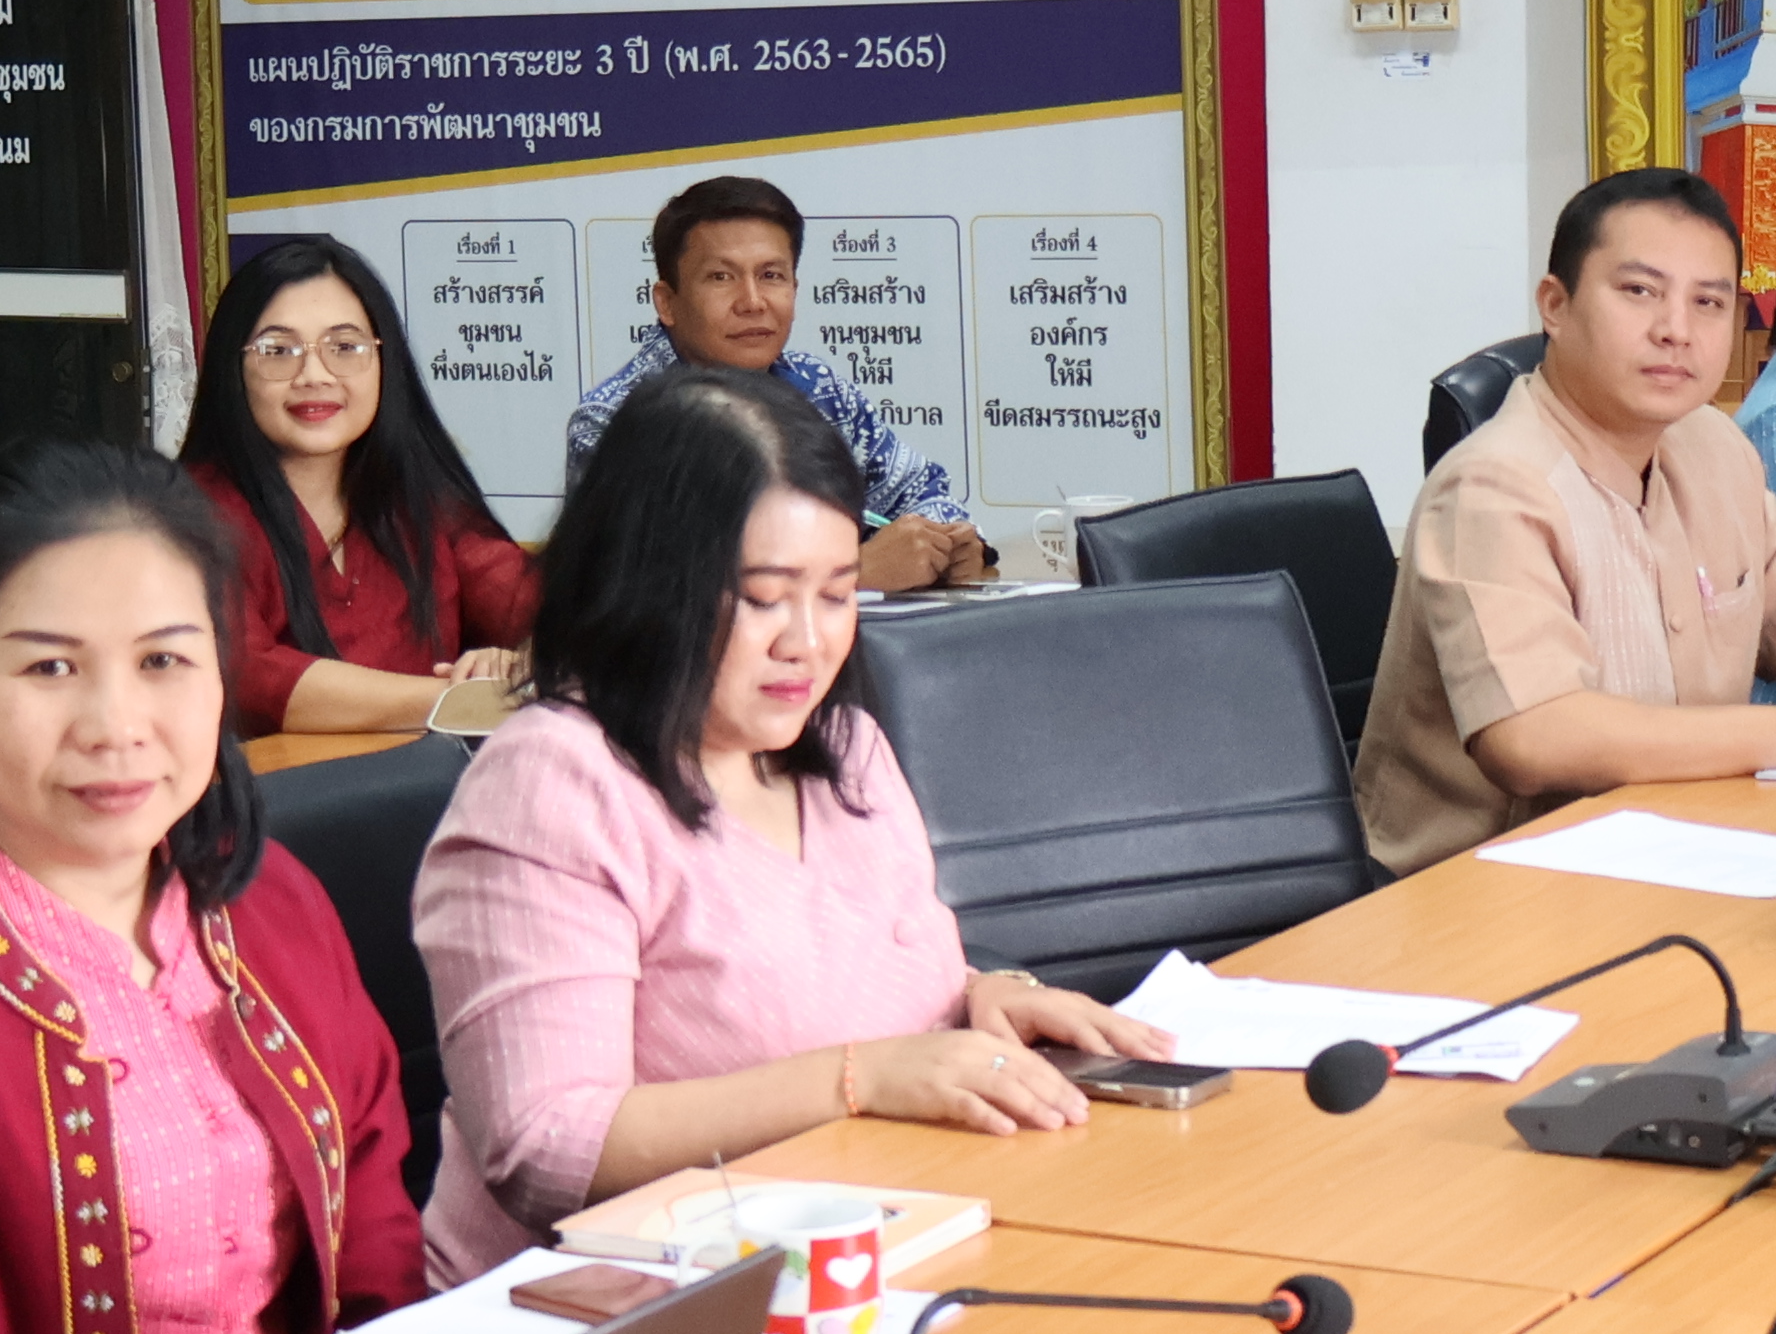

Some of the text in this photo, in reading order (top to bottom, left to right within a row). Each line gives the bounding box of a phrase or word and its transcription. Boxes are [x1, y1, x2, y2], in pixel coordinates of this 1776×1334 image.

[248, 43, 583, 92] แผนปฏิบัติราชการระยะ
[596, 43, 614, 75] 3
[624, 33, 650, 75] ปี
[665, 40, 739, 81] (พ.ศ.
[753, 38, 832, 72] 2563
[249, 102, 602, 154] ของกรมการพัฒนาชุมชน
[456, 233, 517, 257] เรื่องที่ 1
[831, 233, 897, 257] เรื่องที่ 3
[1030, 232, 1098, 257] เรื่องที่ 4
[432, 277, 545, 309] สร้างสรรค์
[812, 277, 927, 309] เสริมสร้าง
[1009, 277, 1128, 309] เสริมสร้าง
[458, 319, 523, 347] ชุมชน
[819, 316, 922, 349] ทุนชุมชน
[1030, 315, 1110, 348] องค์กร
[430, 349, 555, 386] พึ่งตนเองได้
[848, 354, 895, 387] ให้มี
[1046, 352, 1094, 387] ให้มี
[876, 399, 944, 431] ภิบาล
[983, 401, 1163, 441] ขีดสมรรถนะสูง
